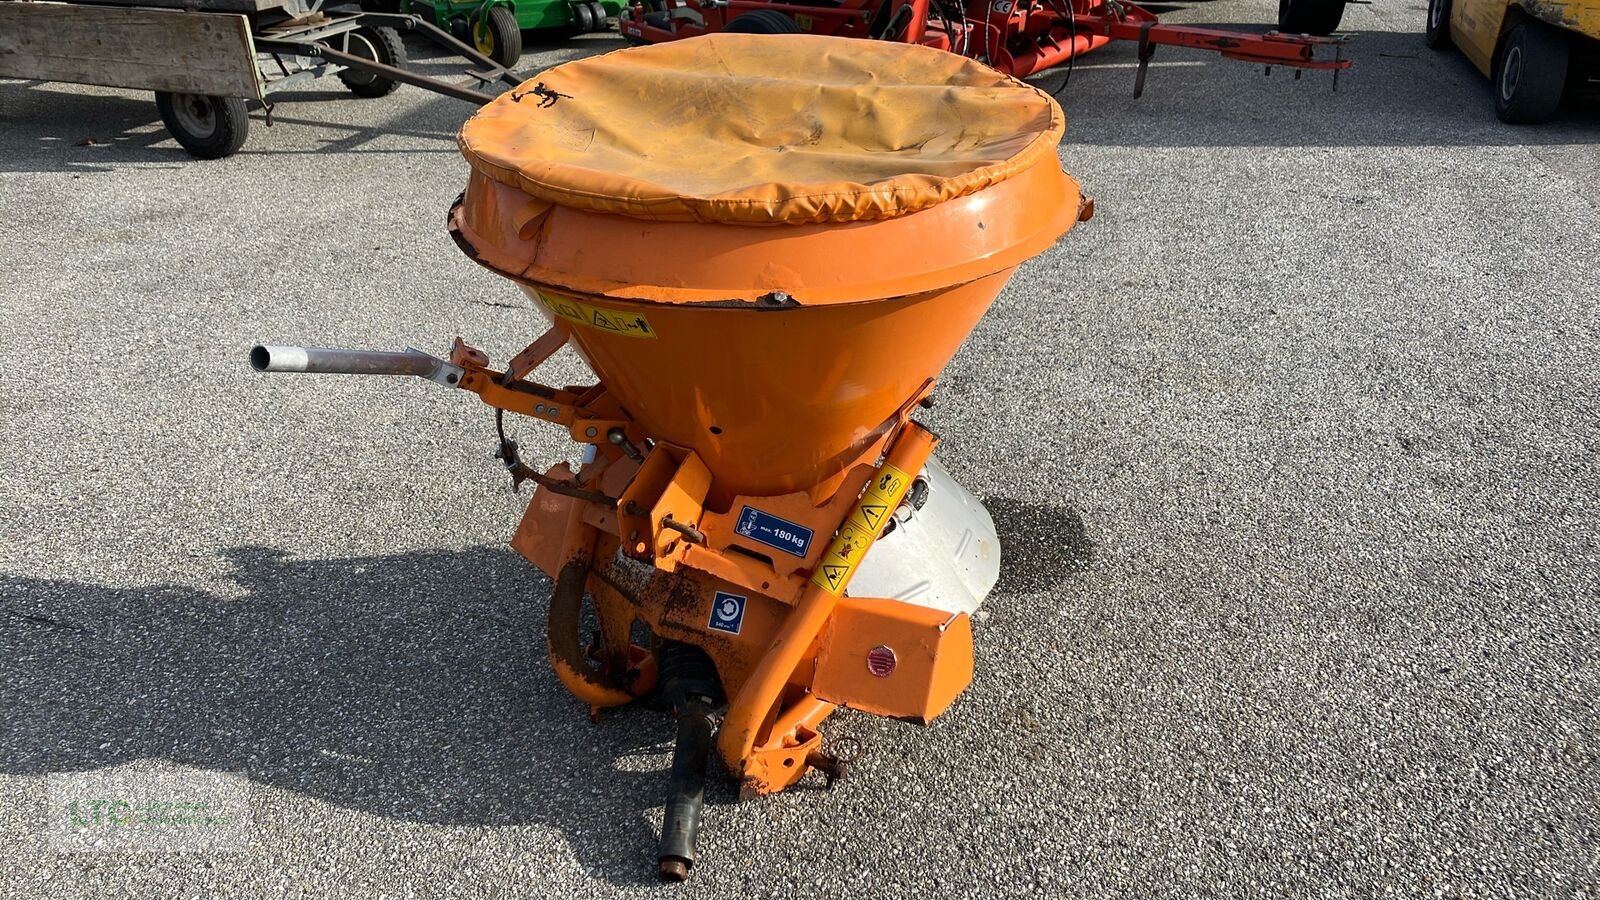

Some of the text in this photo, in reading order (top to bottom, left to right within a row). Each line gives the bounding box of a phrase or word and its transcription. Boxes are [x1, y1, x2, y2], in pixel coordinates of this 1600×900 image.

[994, 0, 1011, 12] CE
[773, 528, 792, 541] 180
[791, 535, 805, 548] kg
